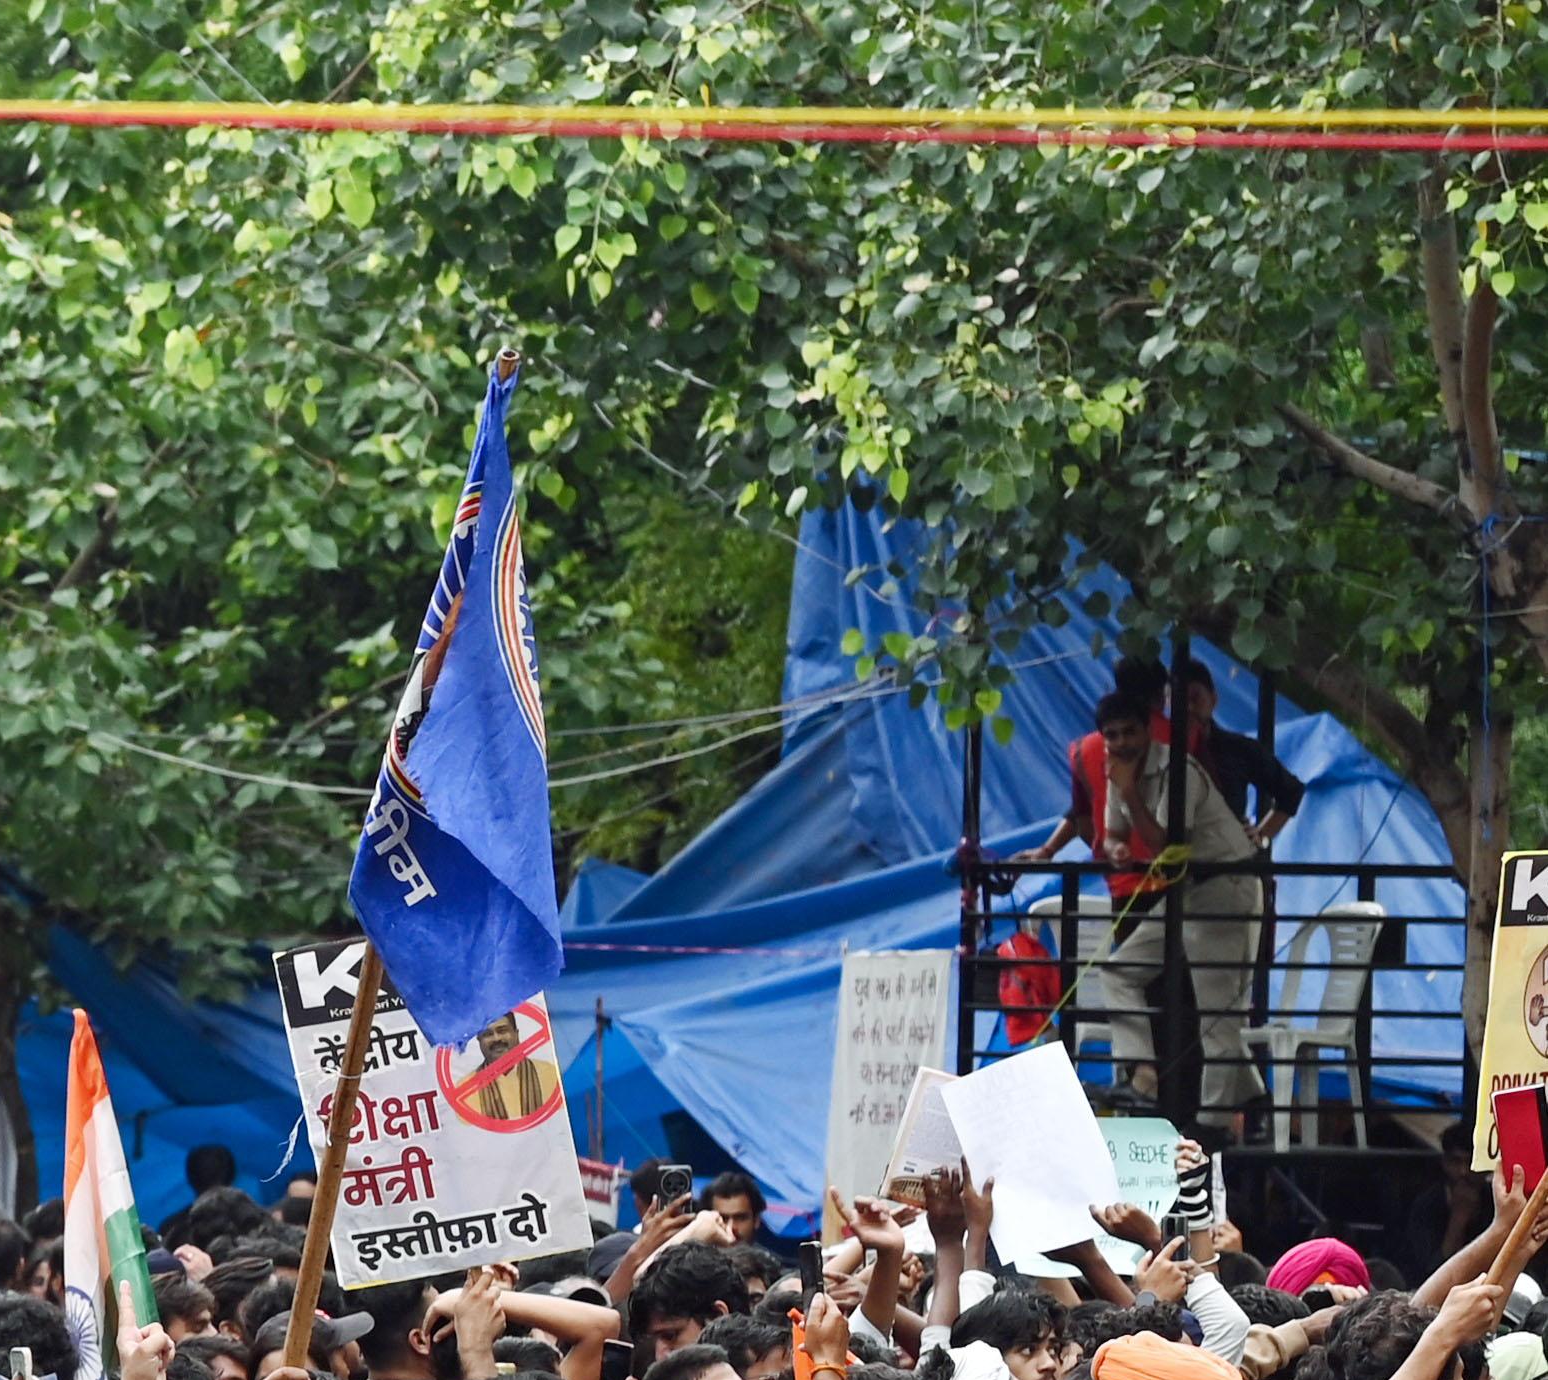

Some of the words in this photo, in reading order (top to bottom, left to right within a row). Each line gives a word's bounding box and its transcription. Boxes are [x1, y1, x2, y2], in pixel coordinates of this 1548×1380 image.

[343, 1146, 435, 1207] मंत्री
[1128, 1140, 1169, 1164] SEEDHE
[503, 1193, 548, 1243] दो
